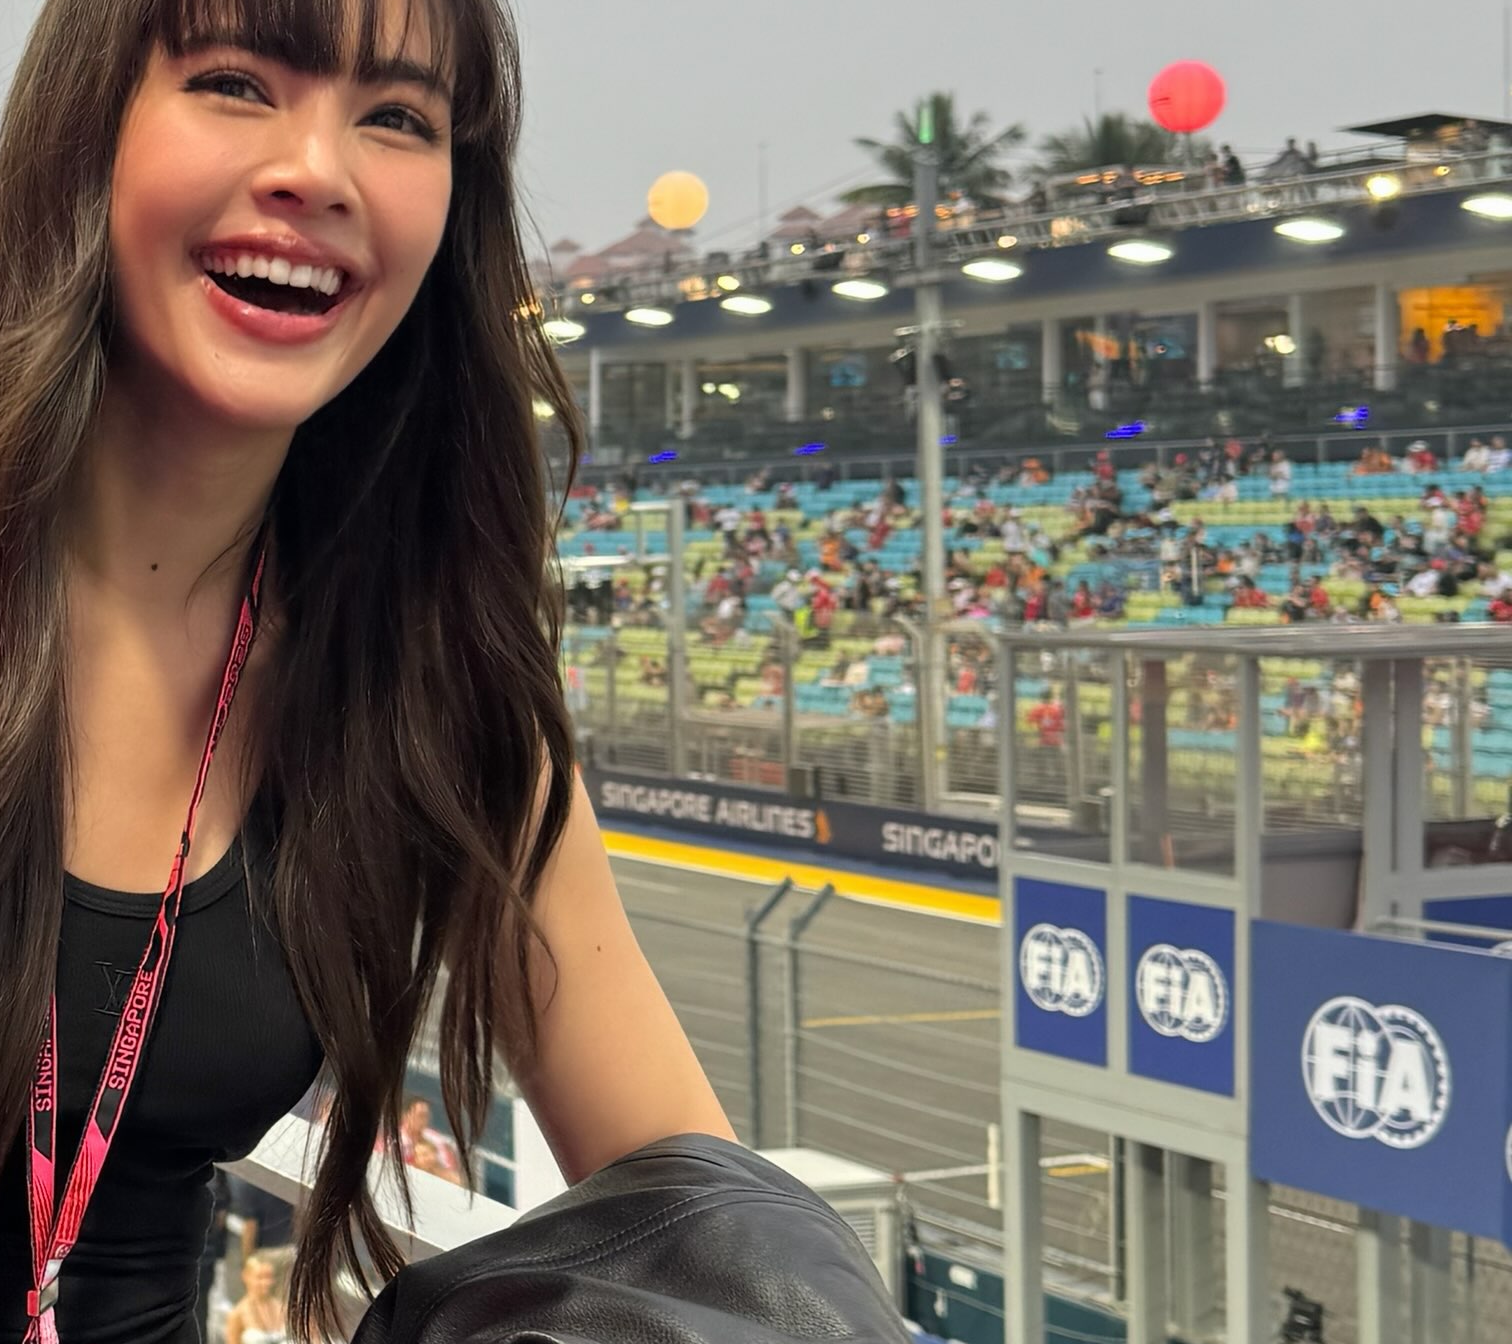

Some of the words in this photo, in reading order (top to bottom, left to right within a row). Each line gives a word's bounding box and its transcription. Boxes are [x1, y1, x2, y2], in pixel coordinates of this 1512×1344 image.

[601, 781, 709, 822] SINGAPORE
[715, 798, 815, 839] AIRLINES
[882, 822, 1001, 868] SINGAPO
[108, 969, 154, 1090] SINGAPORE
